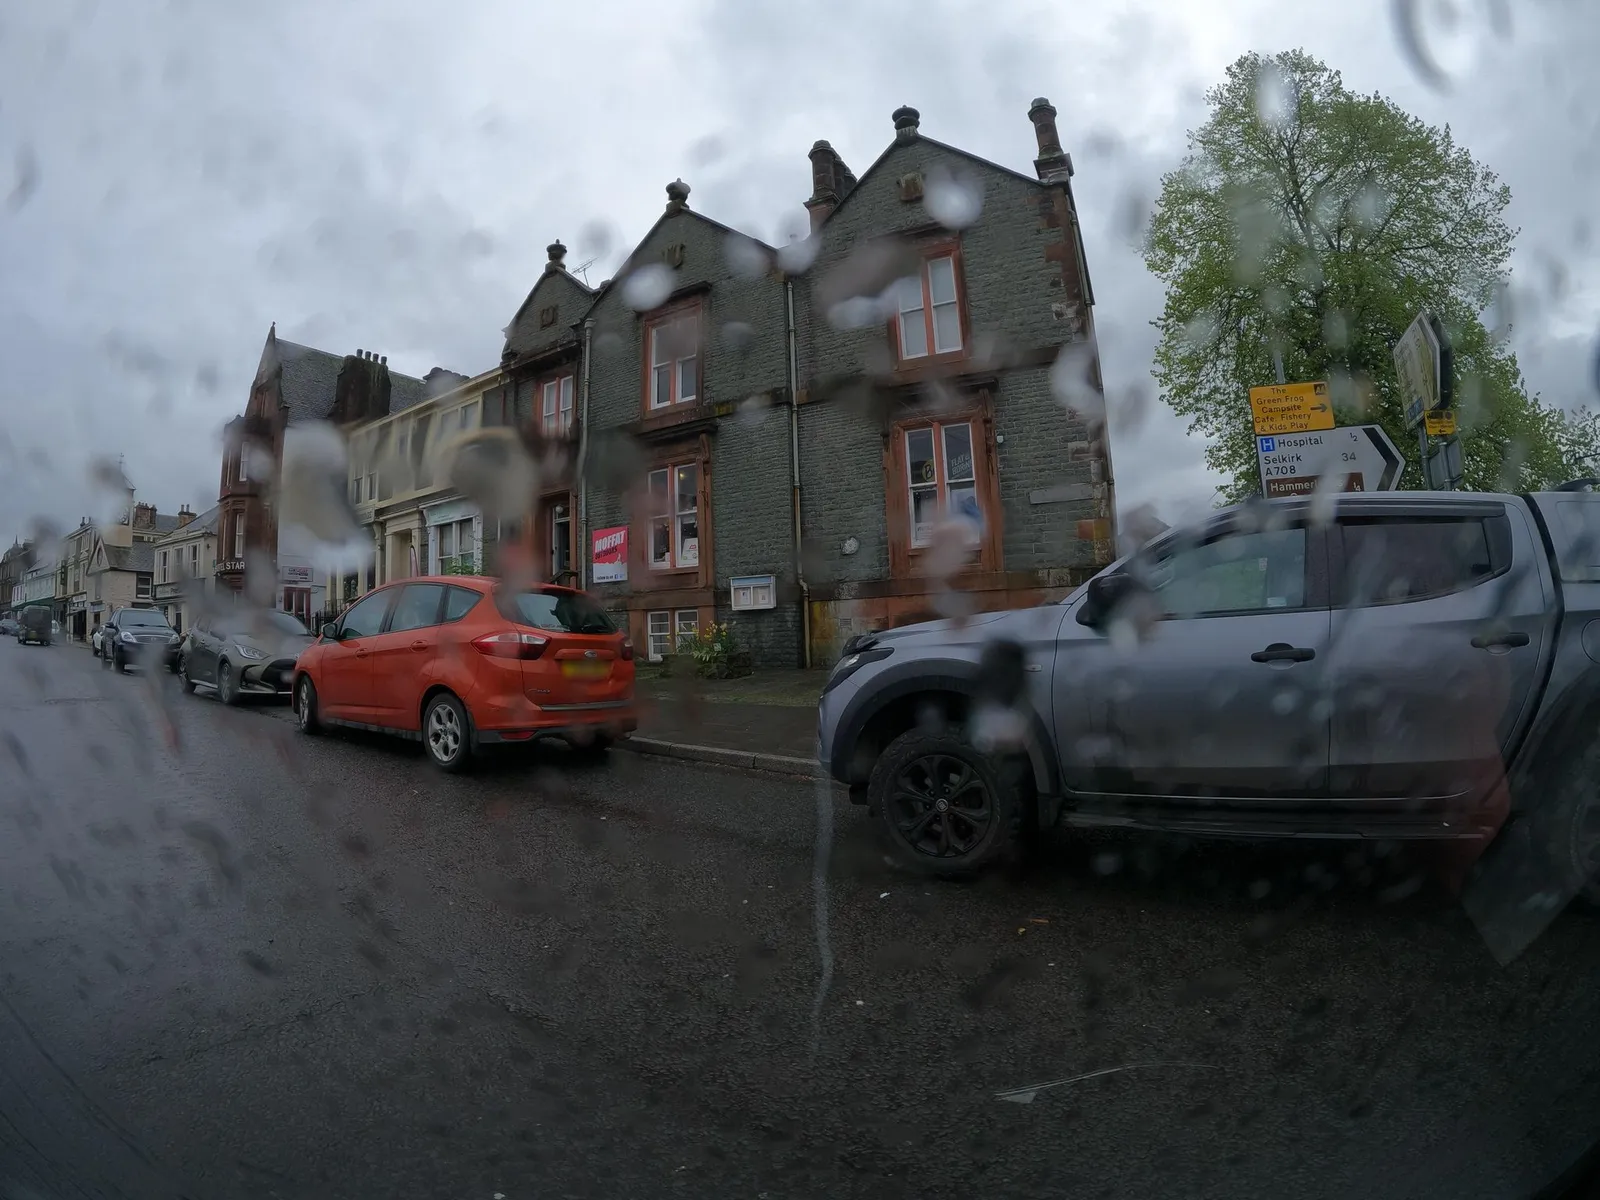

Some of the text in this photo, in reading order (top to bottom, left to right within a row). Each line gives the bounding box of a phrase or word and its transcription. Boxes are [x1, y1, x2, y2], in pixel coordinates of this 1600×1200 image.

[1256, 395, 1304, 405] Green Frog
[1262, 404, 1302, 414] Campsite
[1280, 412, 1312, 421] Fishery
[1278, 436, 1323, 448] Hospital
[1264, 452, 1356, 464] Selkirk 34
[952, 460, 972, 475] BORIN
[1265, 465, 1296, 476] A708
[595, 530, 625, 552] MOFFAT
[226, 561, 246, 570] STAR
